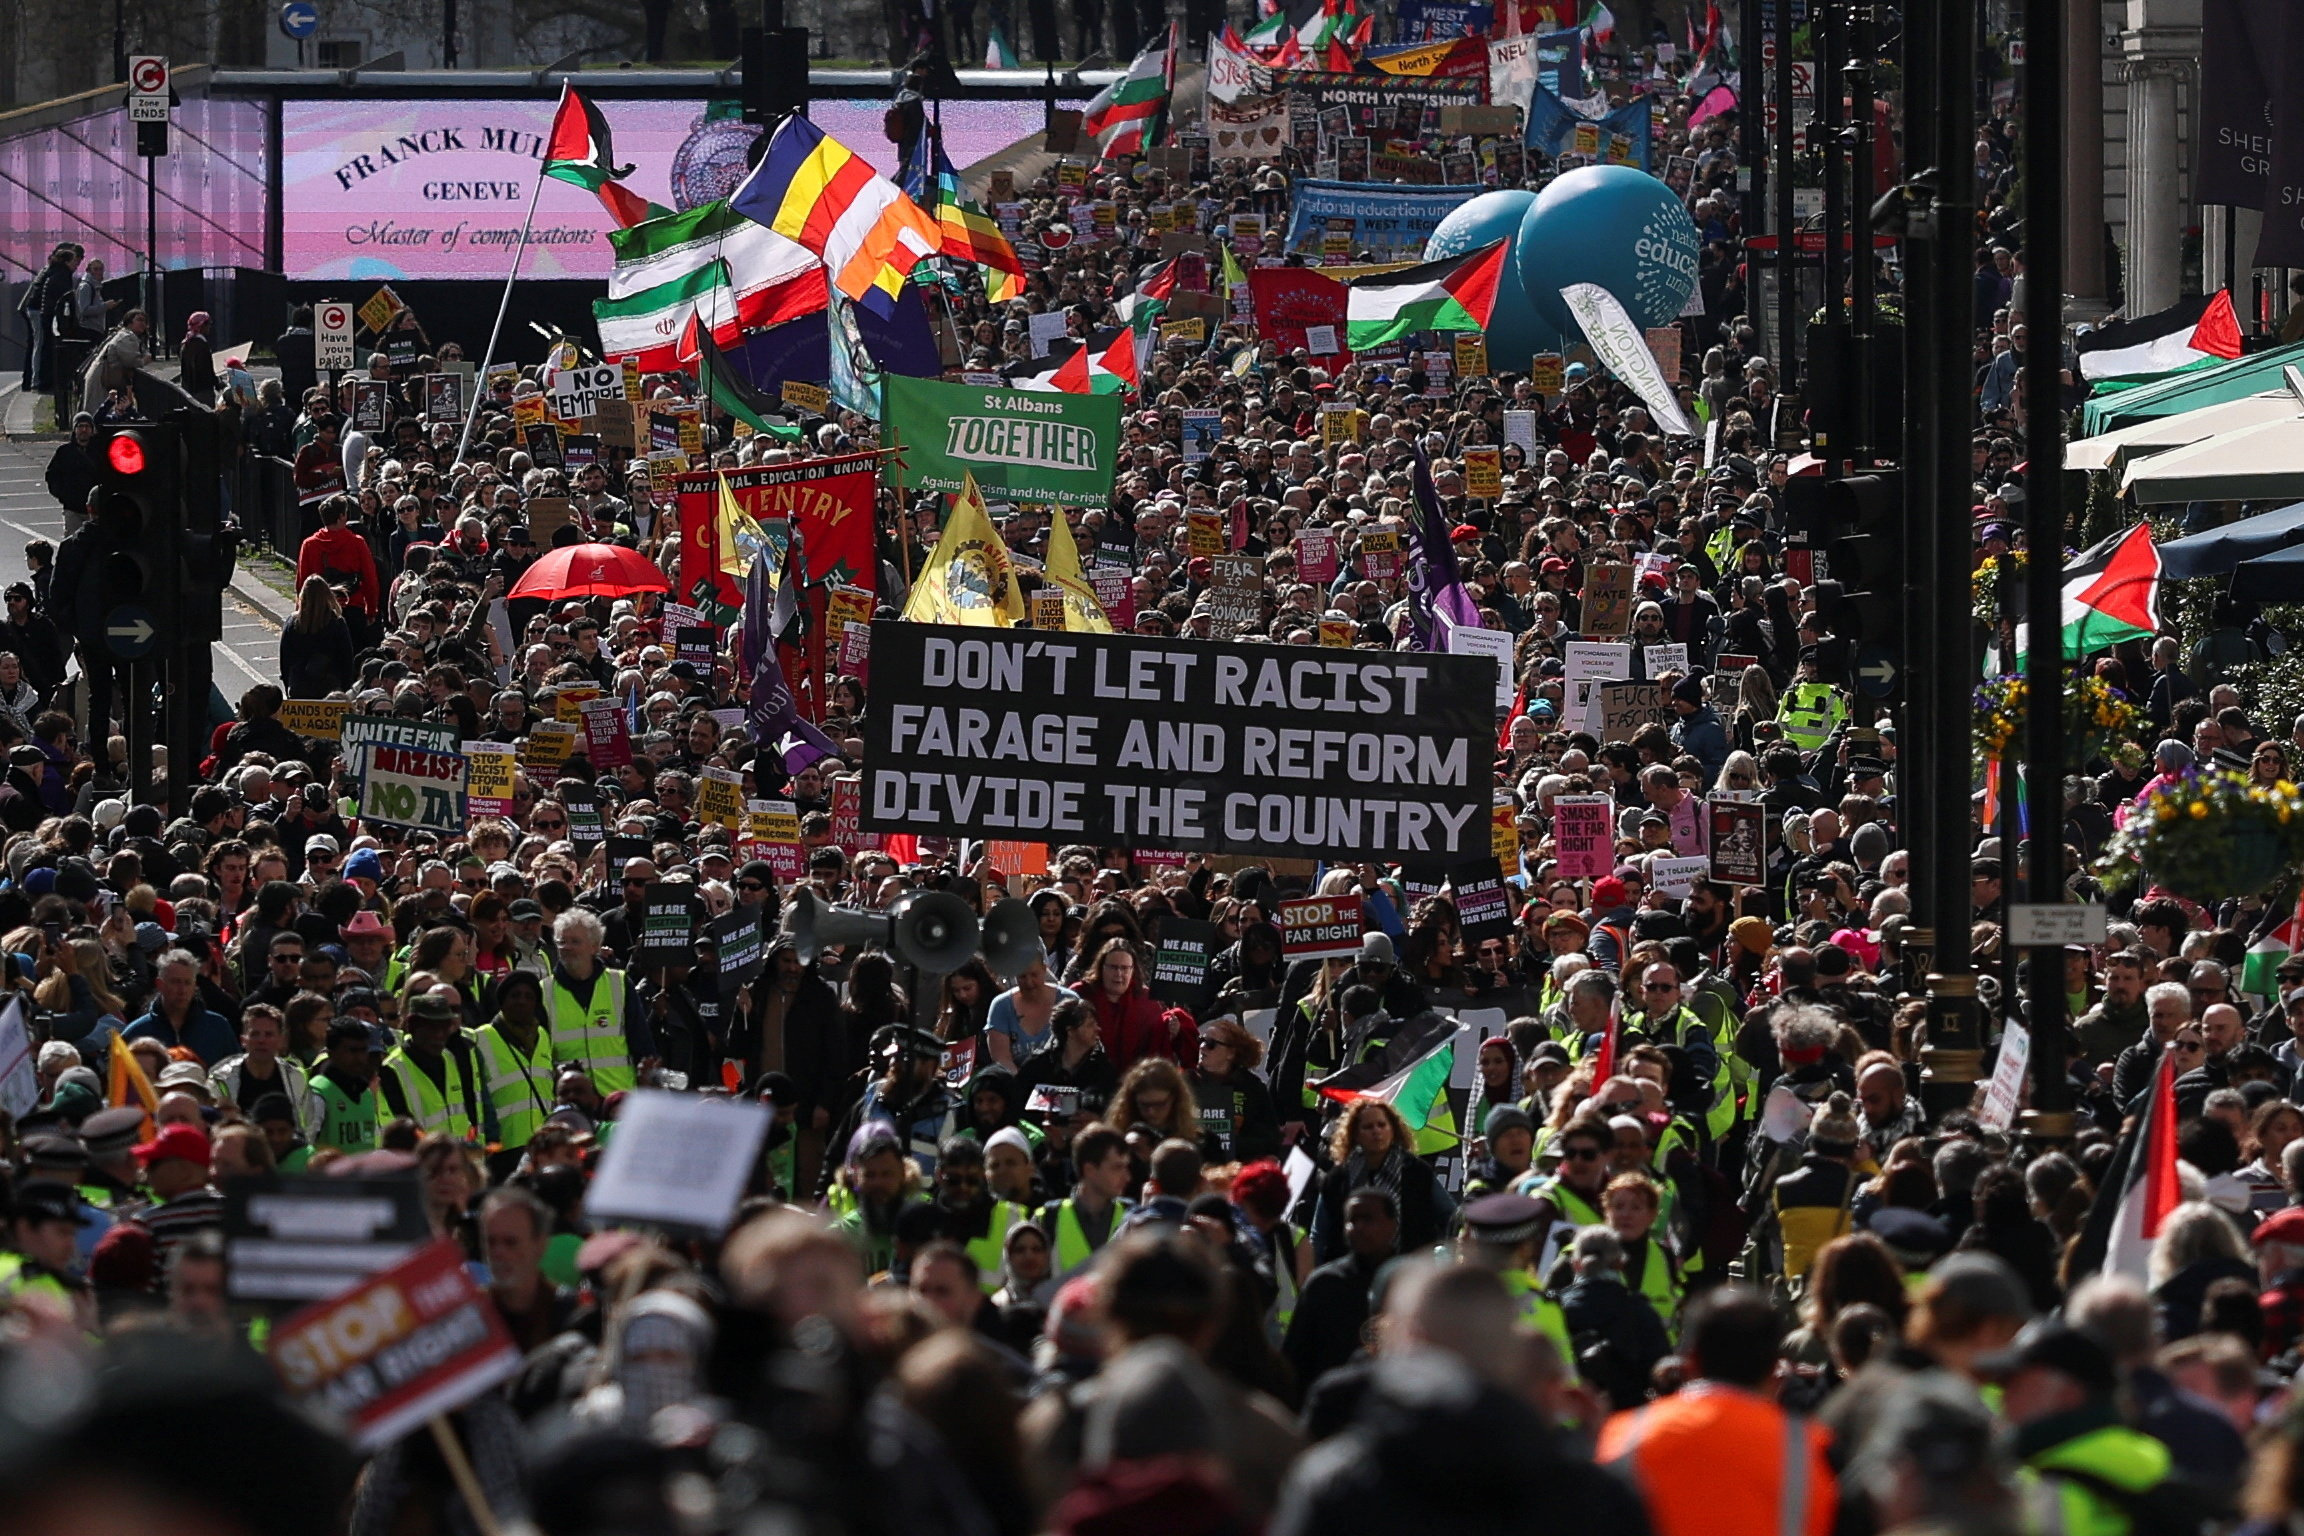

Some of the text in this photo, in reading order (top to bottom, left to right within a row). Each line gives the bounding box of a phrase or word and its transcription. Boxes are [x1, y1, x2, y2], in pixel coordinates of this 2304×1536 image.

[1398, 56, 1431, 71] North
[1322, 90, 1378, 104] NORTH
[134, 109, 165, 118] ENDS
[334, 127, 465, 192] FRANCK
[423, 182, 520, 200] GENEVE
[1301, 198, 1425, 218] national education
[1364, 219, 1398, 231] WEST
[346, 220, 597, 253] Master of compications
[321, 333, 348, 342] Have
[325, 346, 343, 354] you
[319, 355, 350, 367] paid?
[573, 369, 614, 391] NO
[985, 395, 1063, 414] St Albans
[948, 418, 1096, 470] TOGETHER
[683, 459, 874, 493] NATINAL EDUCATION UNION
[1010, 487, 1032, 499] and
[1035, 488, 1054, 500] the
[1058, 489, 1107, 505] far-right
[1363, 535, 1376, 543] NO
[1302, 543, 1331, 551] AGAINST
[1364, 542, 1393, 551] RACISM
[1302, 557, 1322, 565] RIGHT
[1315, 550, 1328, 558] FAR
[1213, 559, 1258, 577] FEAR
[1367, 562, 1378, 570] TO
[1368, 568, 1395, 578] TRUMP
[1096, 578, 1123, 586] WOMEN
[1226, 577, 1241, 587] IS
[1097, 586, 1127, 594] AGAINST
[1112, 592, 1126, 600] FAR
[1593, 590, 1627, 599] HATE
[665, 613, 698, 627] WOMEN
[1210, 605, 1261, 622] COURAGE
[681, 643, 710, 652] WE ARE
[1657, 655, 1684, 663] STARTED
[923, 638, 1428, 715] DON'T LET RACIST
[1612, 687, 1659, 706] FUCK
[281, 705, 346, 716] HANDS OFF
[588, 711, 613, 720] WOMEN
[289, 718, 337, 731] AL-AQSA
[589, 718, 619, 728] AGAINST
[1607, 707, 1664, 729] FASCISM
[346, 721, 411, 744] UNITE
[591, 726, 619, 736] THE FAR
[530, 733, 565, 744] Oppose
[592, 735, 613, 745] RIGHT
[892, 704, 1468, 786] FARAGE AND REFORM
[529, 743, 560, 755] Tommy
[373, 746, 464, 782] NAZIS?
[473, 753, 502, 765] STOP
[468, 764, 508, 776] RACIST
[477, 784, 495, 796] UK
[709, 782, 732, 794] STOP
[369, 780, 418, 820] NO
[469, 798, 502, 807] Refugees
[705, 791, 735, 805] RACIST
[469, 806, 501, 814] welcome
[567, 804, 594, 813] WE ARE
[703, 802, 737, 817] REFORM
[872, 769, 1478, 852] DIVIDE THE COUNTRY
[1560, 807, 1599, 821] SMASH
[754, 814, 797, 828] Refugees
[754, 828, 796, 839] welcome
[1561, 822, 1606, 836] THE FAR
[572, 833, 603, 842] FAR RIGHT
[834, 832, 879, 848] HATE
[1562, 837, 1595, 852] RIGHT
[756, 843, 796, 858] Stop the
[1166, 851, 1184, 861] right
[772, 857, 797, 872] right
[1417, 883, 1438, 894] ARE
[1458, 878, 1498, 895] WE ARE
[649, 904, 687, 916] WE ARE
[1284, 904, 1358, 927] STOP THE
[1459, 900, 1506, 917] AGAINST THE
[1461, 909, 1508, 926] FAR RIGHT
[645, 929, 689, 937] AGAINST THE
[722, 922, 756, 945] WE ARE
[1285, 923, 1359, 944] FAR RIGHT
[644, 937, 690, 948] FAR RIGHT
[1163, 939, 1204, 953] WE ARE
[720, 950, 760, 973] FAR RIGHT
[1157, 951, 1207, 965] TOGETHER
[1156, 963, 1205, 975] AGAINST THE
[1154, 971, 1204, 985] FAR RIGHT
[956, 1049, 972, 1063] THE
[947, 1061, 971, 1081] GHT
[1203, 1108, 1226, 1119] ARE
[278, 1285, 403, 1385] STOP
